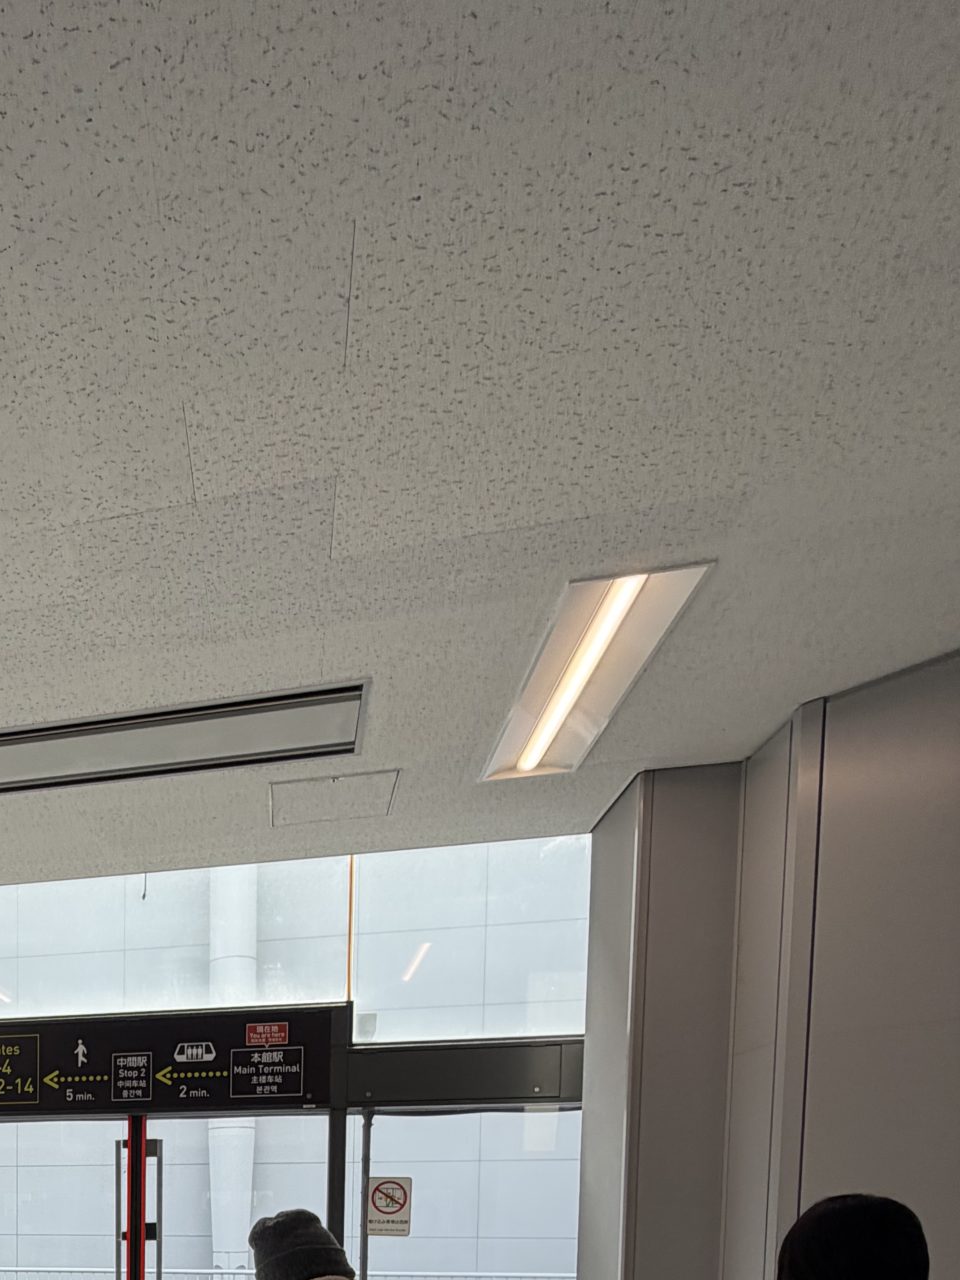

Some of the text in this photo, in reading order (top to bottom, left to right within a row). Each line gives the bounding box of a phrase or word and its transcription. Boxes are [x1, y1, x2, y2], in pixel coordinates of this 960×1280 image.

[116, 1056, 148, 1068] 中間駅
[250, 1051, 284, 1063] 本館駅
[118, 1068, 146, 1079] Stop 2
[233, 1063, 300, 1075] Main Terminal
[66, 1088, 95, 1101] 5 min.
[179, 1085, 210, 1098] 2 min.
